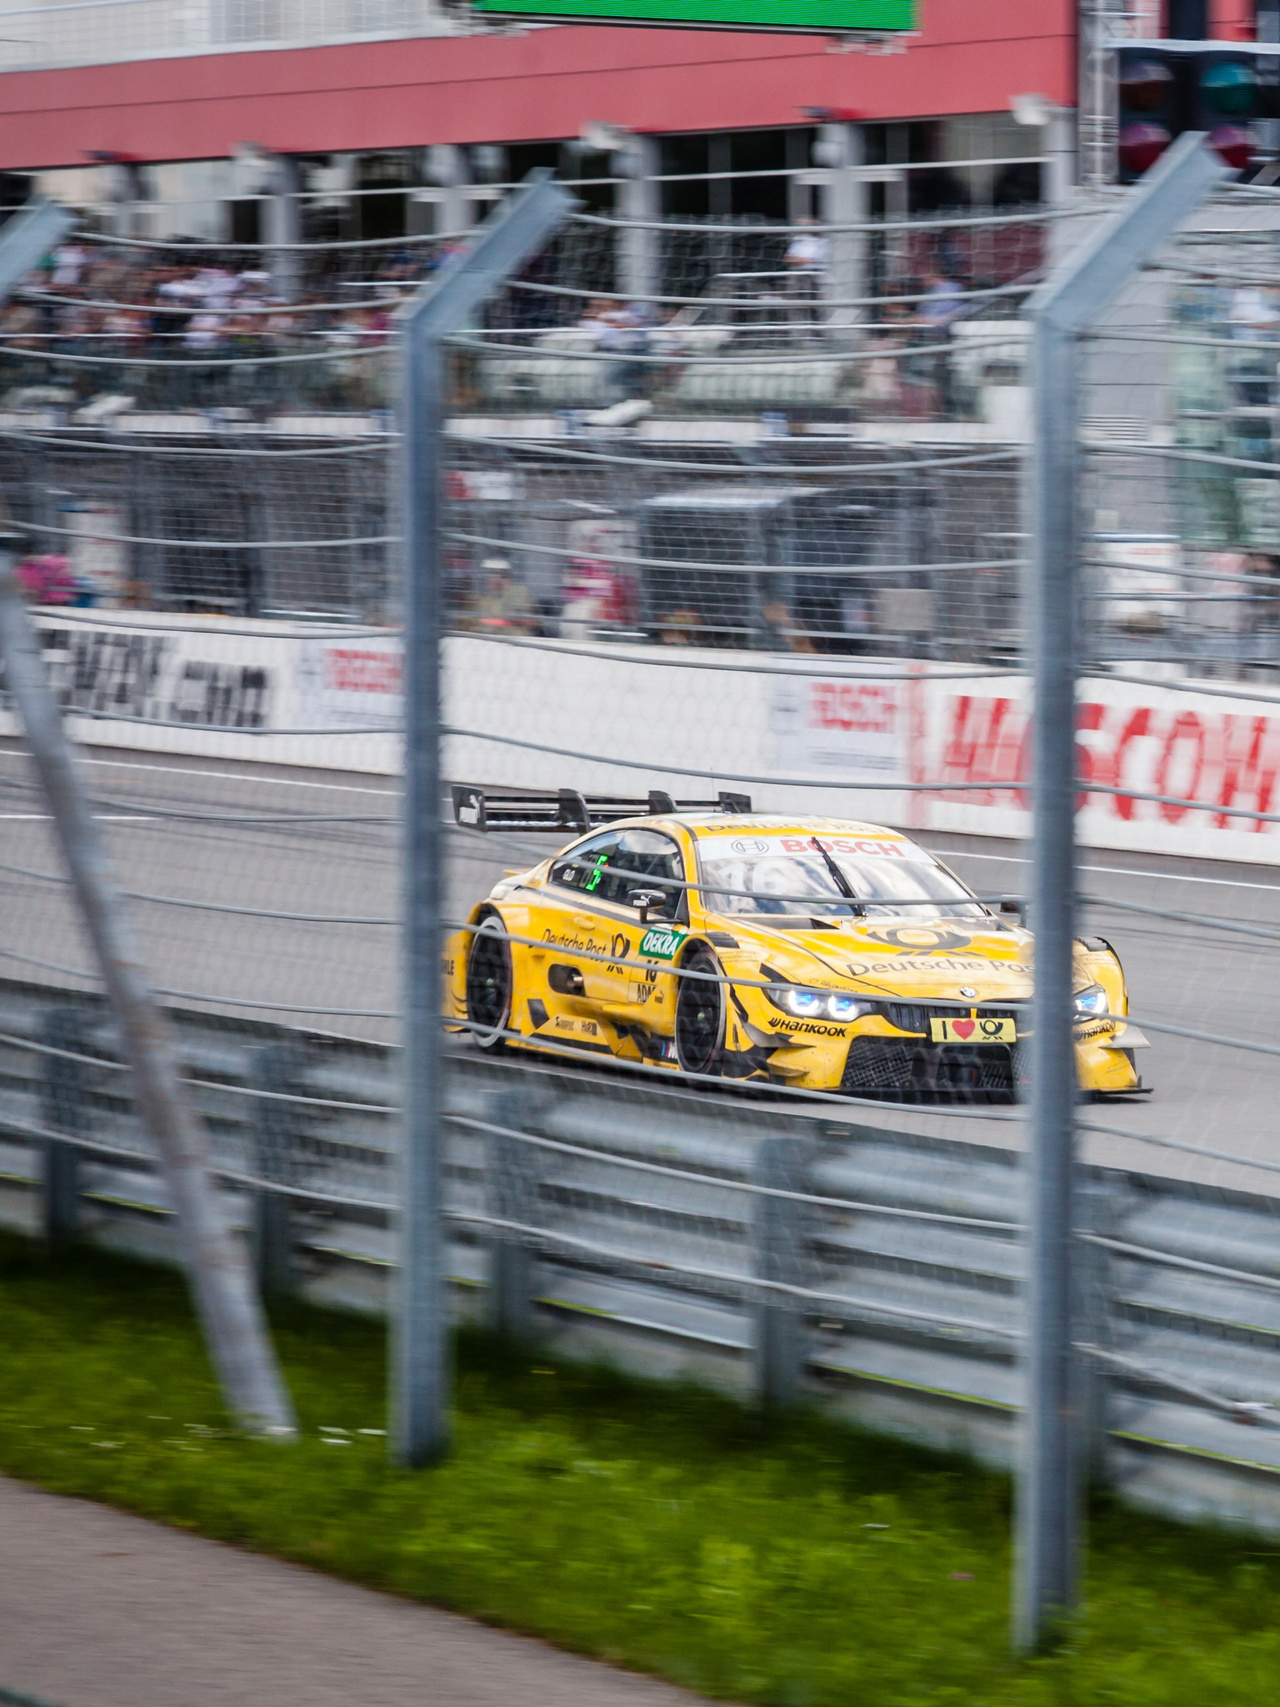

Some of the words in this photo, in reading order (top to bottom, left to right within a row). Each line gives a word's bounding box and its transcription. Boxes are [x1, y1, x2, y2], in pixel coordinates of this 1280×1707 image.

[779, 839, 906, 857] BOSCH
[643, 932, 679, 956] DEKRA
[846, 959, 985, 977] Deutsche
[988, 960, 1036, 975] Pos
